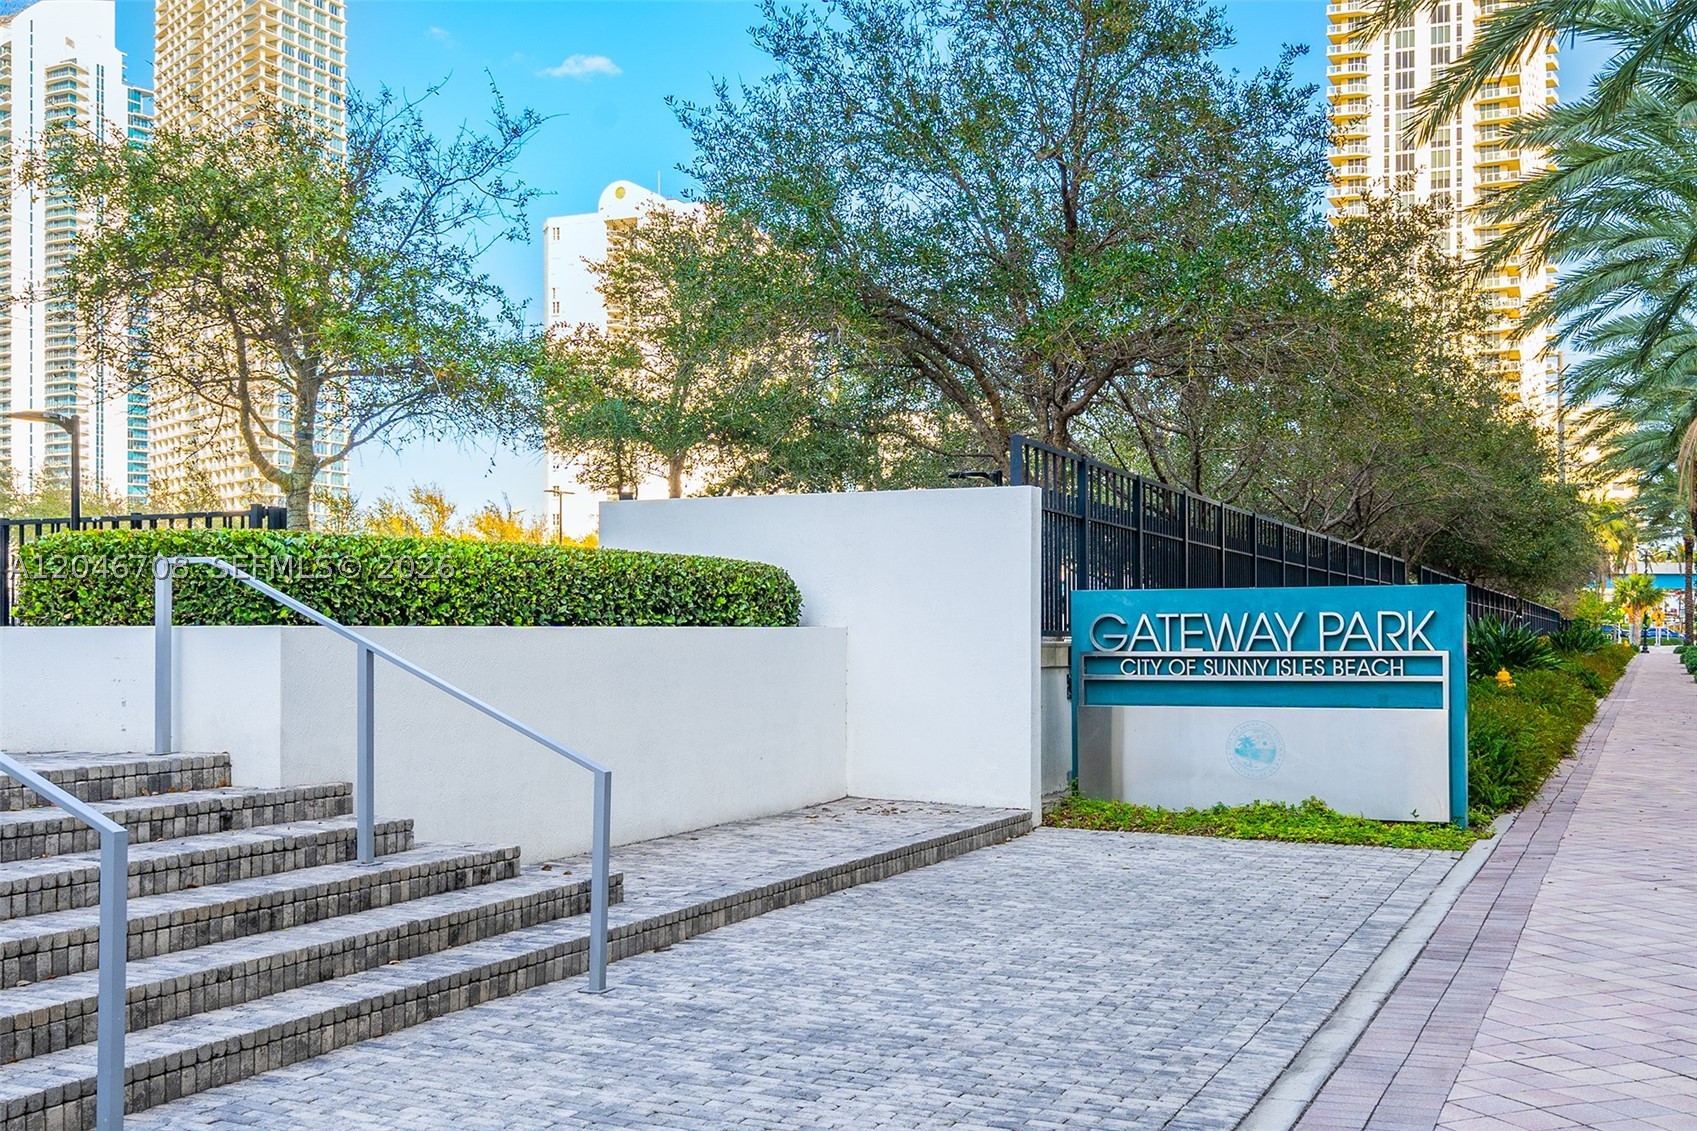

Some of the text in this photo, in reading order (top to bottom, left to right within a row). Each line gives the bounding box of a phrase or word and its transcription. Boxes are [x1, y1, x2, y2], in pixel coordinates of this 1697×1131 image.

[1090, 610, 1436, 652] GATEWAY PARK
[1120, 658, 1404, 676] CITY OF SUNNY ISLES BEACH
